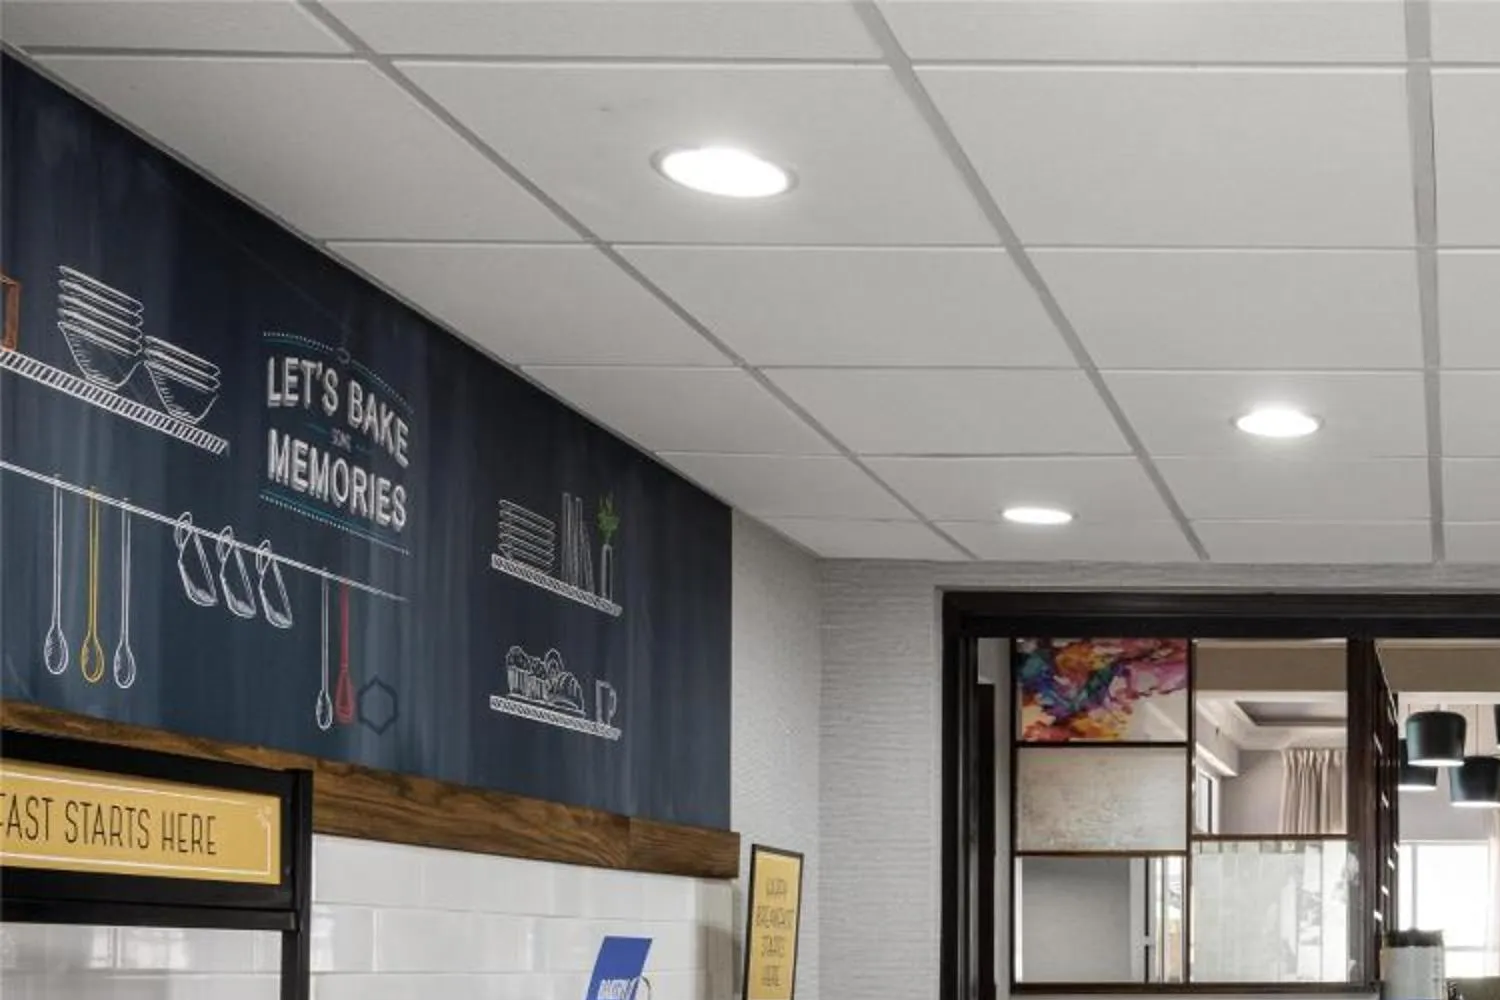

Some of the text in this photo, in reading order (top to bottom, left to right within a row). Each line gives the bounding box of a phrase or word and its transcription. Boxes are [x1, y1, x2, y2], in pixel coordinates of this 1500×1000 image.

[267, 355, 409, 468] LET'S BAKE
[267, 427, 407, 531] MEMORIES
[64, 800, 151, 850] STARTS
[161, 811, 217, 856] HERE
